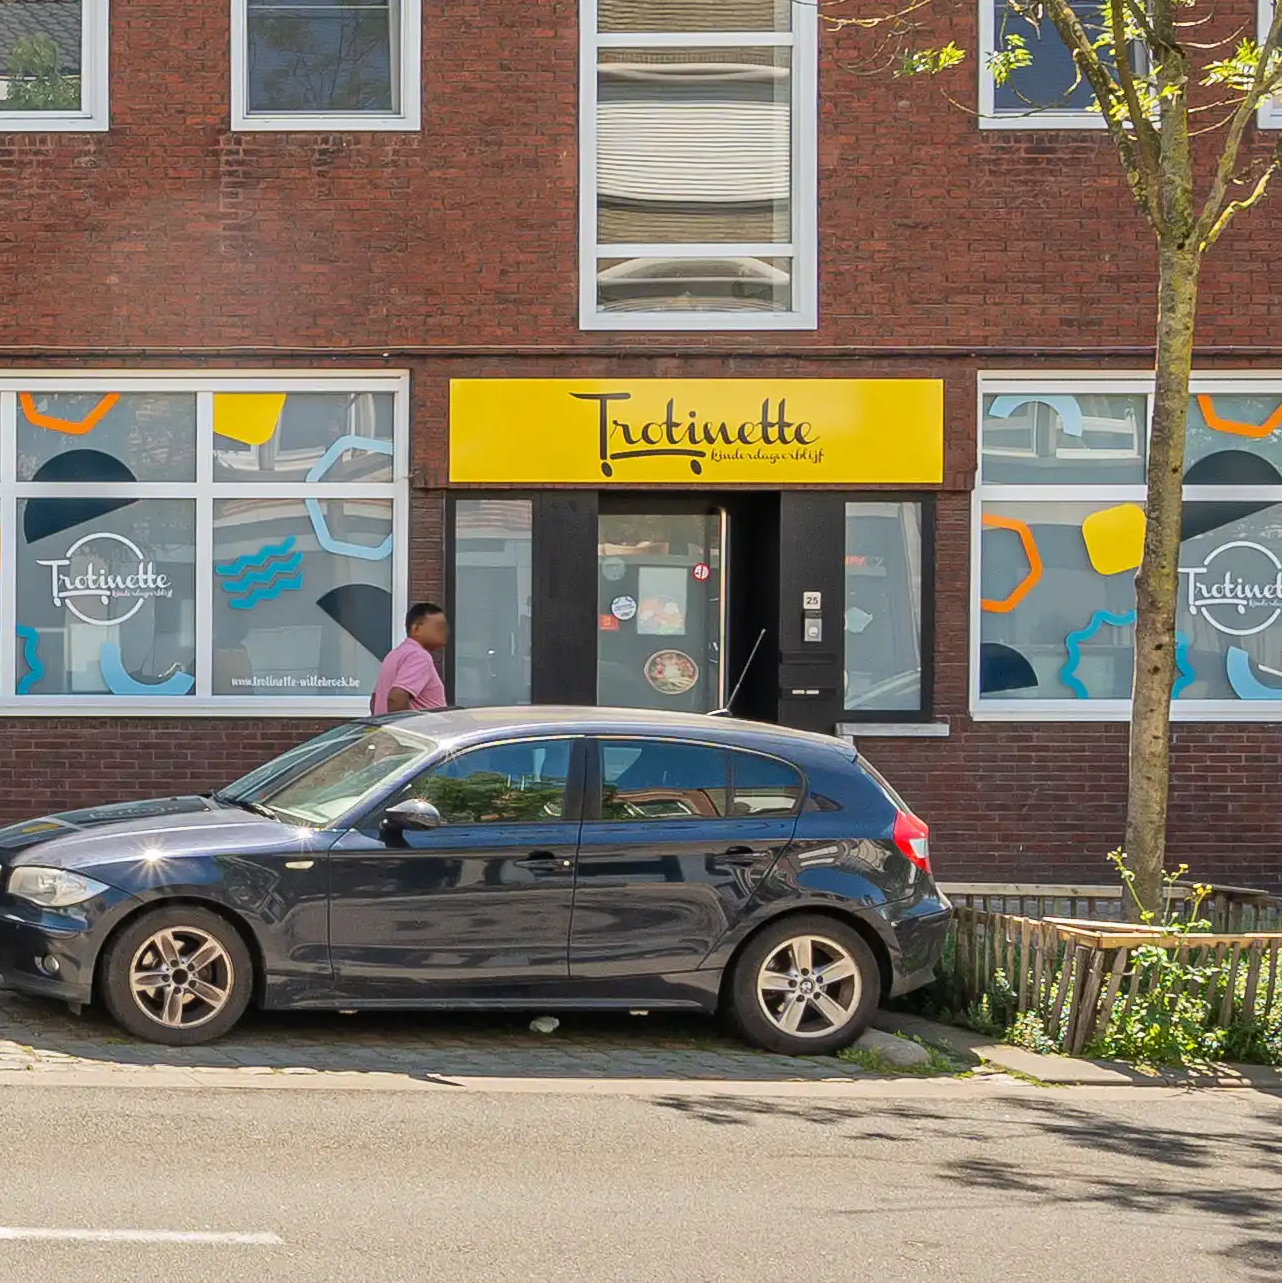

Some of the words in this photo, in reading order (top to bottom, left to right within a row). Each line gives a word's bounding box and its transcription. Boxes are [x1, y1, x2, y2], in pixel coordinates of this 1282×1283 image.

[568, 392, 820, 461] Trotinette
[35, 559, 172, 599] Trotinette
[806, 597, 819, 605] 25
